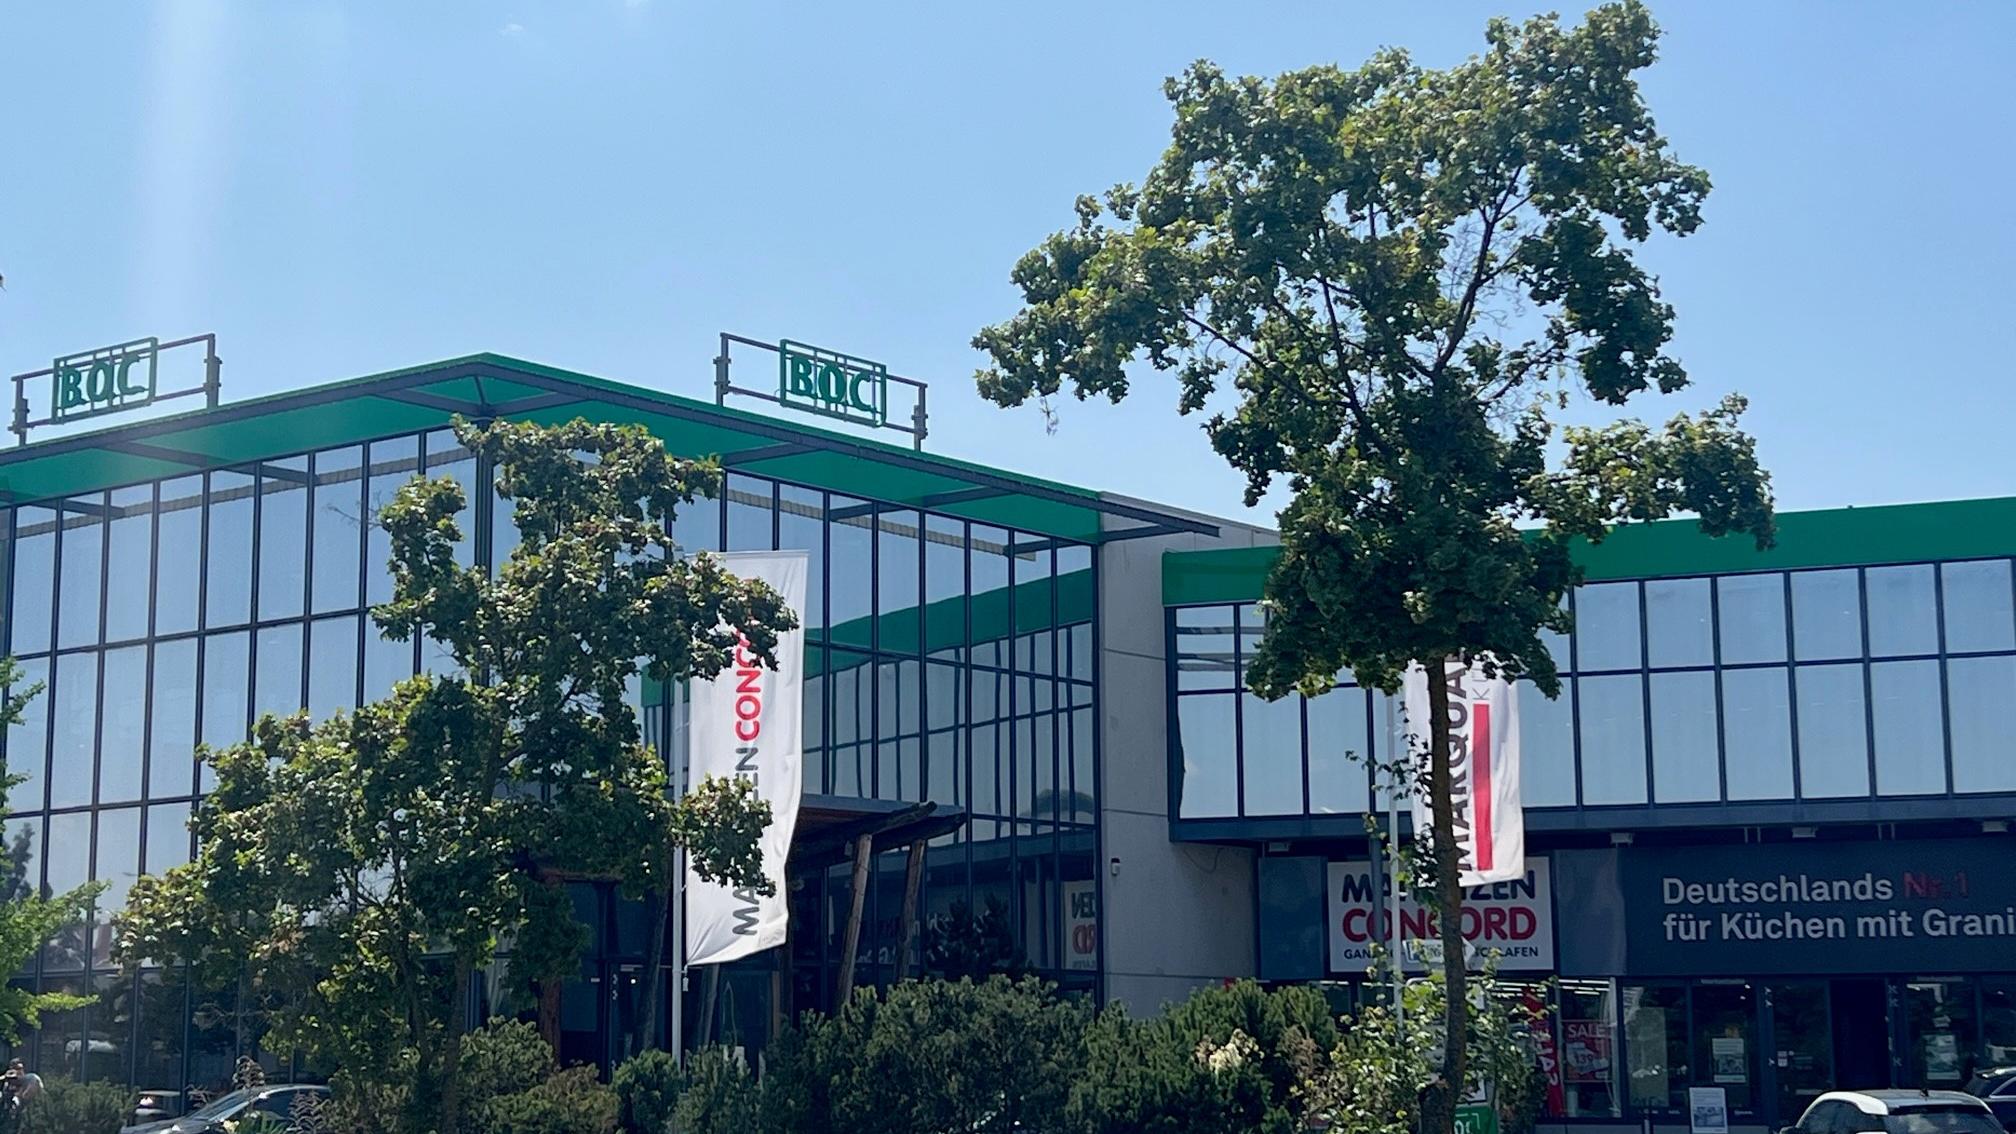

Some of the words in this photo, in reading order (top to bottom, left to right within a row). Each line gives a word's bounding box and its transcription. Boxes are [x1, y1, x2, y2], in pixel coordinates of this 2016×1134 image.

[60, 352, 147, 408] BOC
[790, 355, 877, 413] BOC
[1663, 873, 1893, 905] Deutschlands
[1663, 913, 1712, 941] für
[1721, 911, 1846, 940] Küchen
[1857, 907, 1914, 938] mit
[1568, 1023, 1606, 1038] SALE
